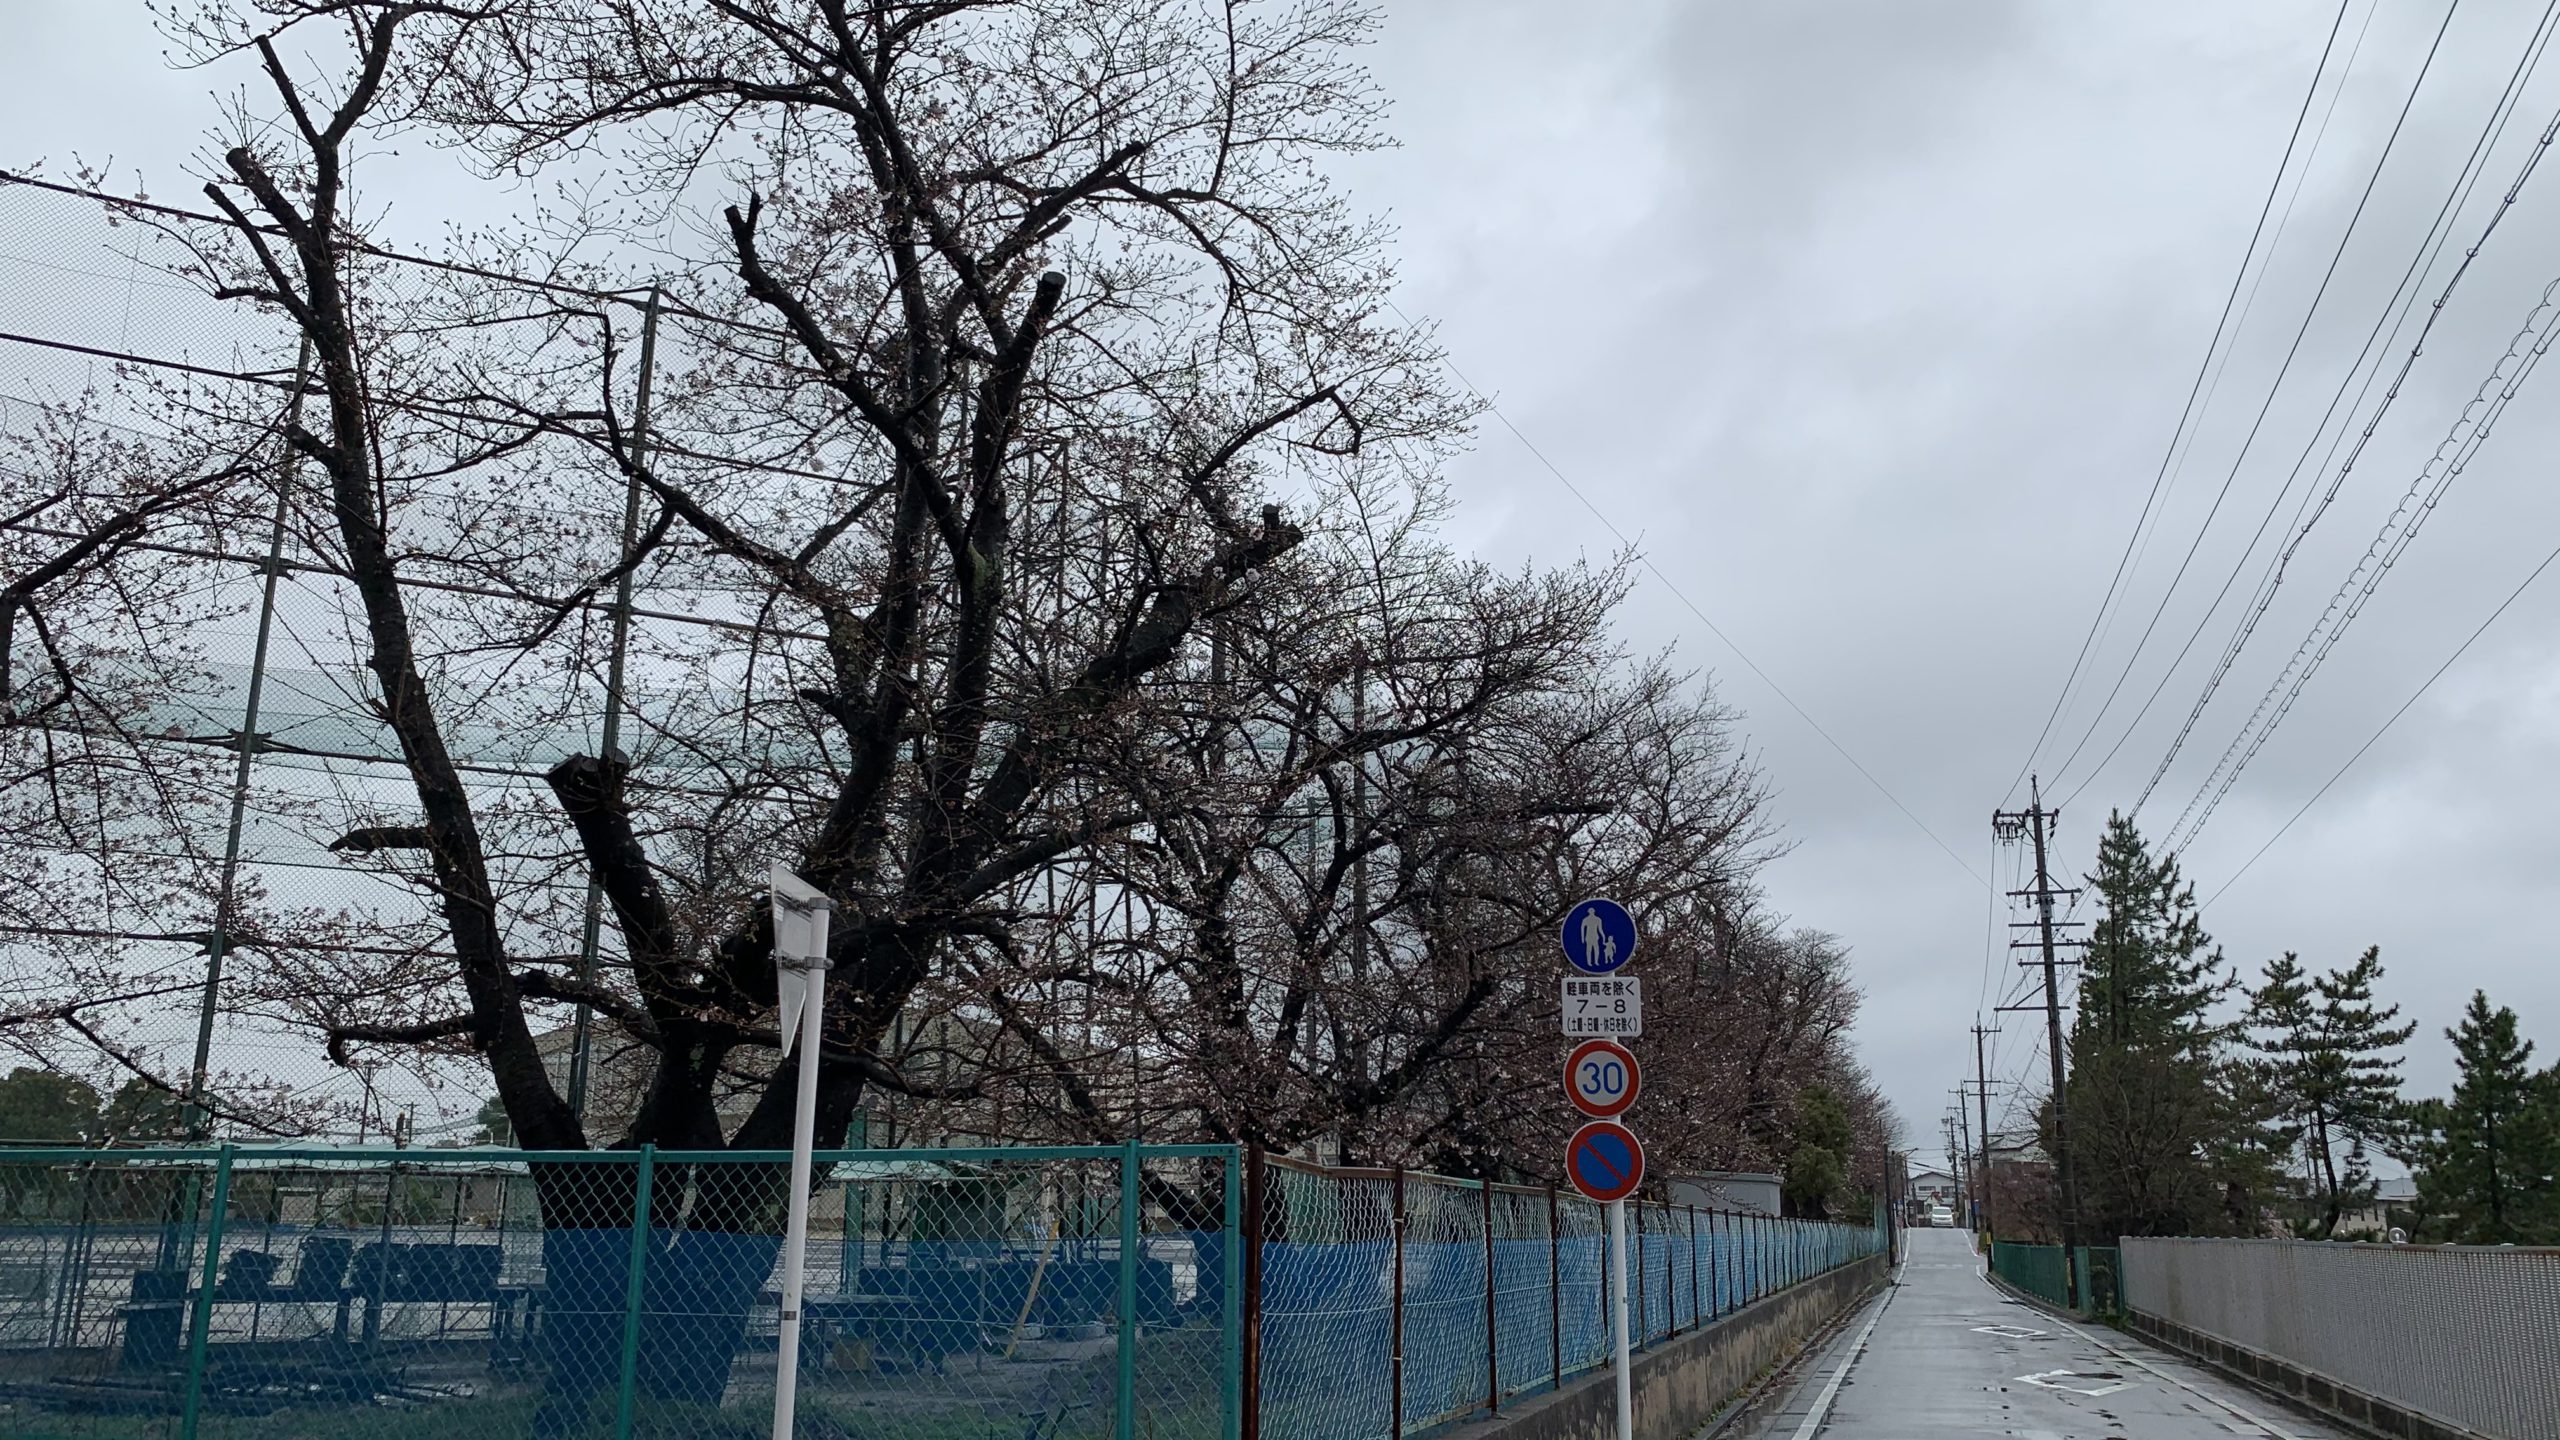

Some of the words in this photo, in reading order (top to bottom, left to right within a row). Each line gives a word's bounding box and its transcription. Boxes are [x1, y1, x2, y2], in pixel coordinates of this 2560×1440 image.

[1567, 981, 1634, 996] 軽車両を除く
[1582, 1062, 1623, 1095] 30
